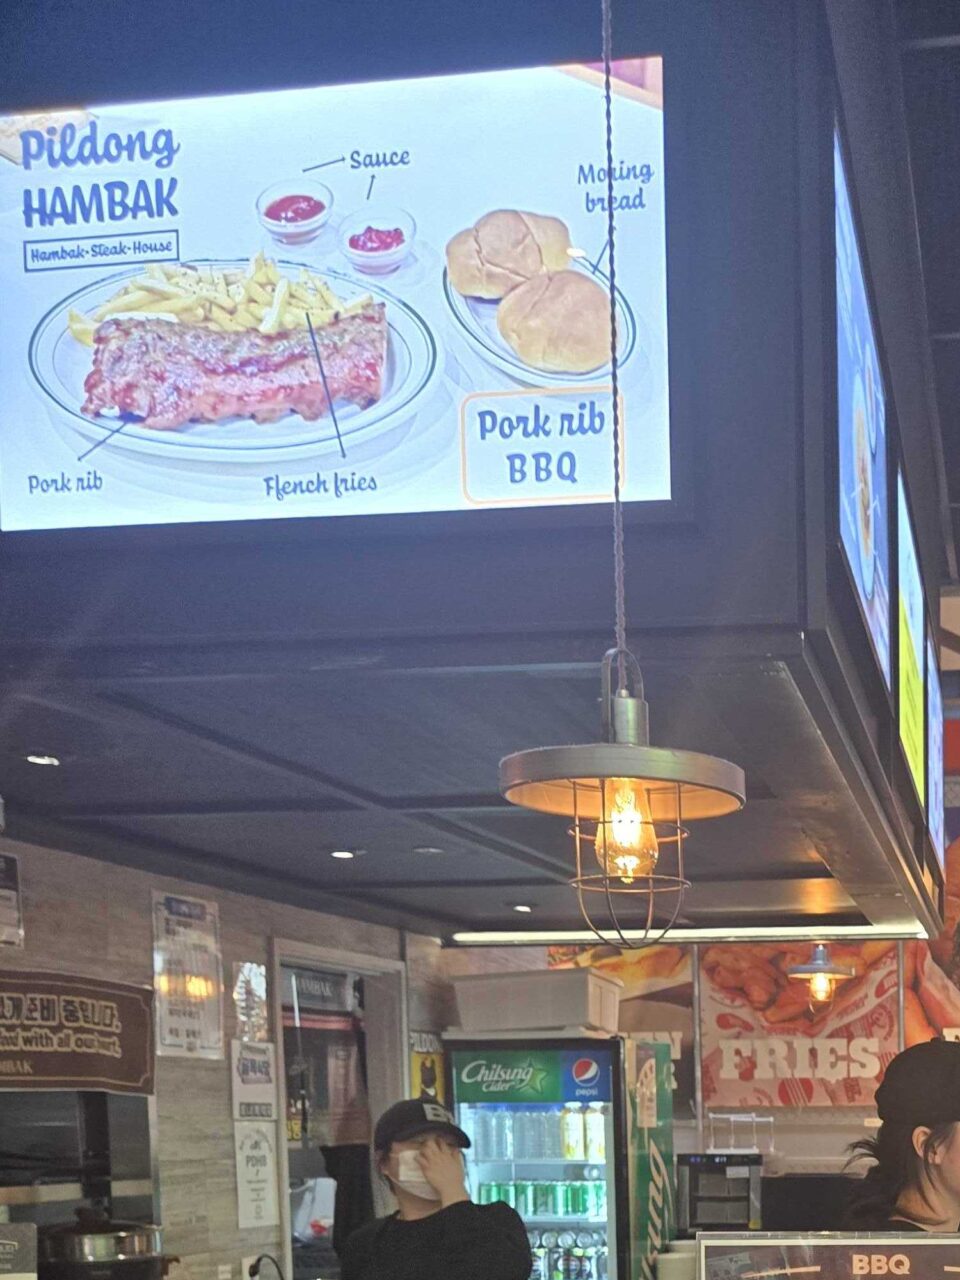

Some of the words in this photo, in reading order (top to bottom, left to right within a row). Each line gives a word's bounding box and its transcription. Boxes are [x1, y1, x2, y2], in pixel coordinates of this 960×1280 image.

[19, 120, 180, 170] Pildong
[350, 147, 410, 169] Sauce
[23, 177, 178, 228] HAMBAK
[478, 403, 551, 442] Pork
[557, 400, 607, 438] rib
[505, 451, 577, 484] BBQ
[28, 471, 72, 494] Pork
[76, 471, 103, 492] rib
[334, 472, 378, 498] fries
[719, 1037, 882, 1080] FRIES
[461, 1059, 534, 1085] Chilsung
[575, 1088, 599, 1097] pepsi
[853, 1254, 911, 1275] BBQ
